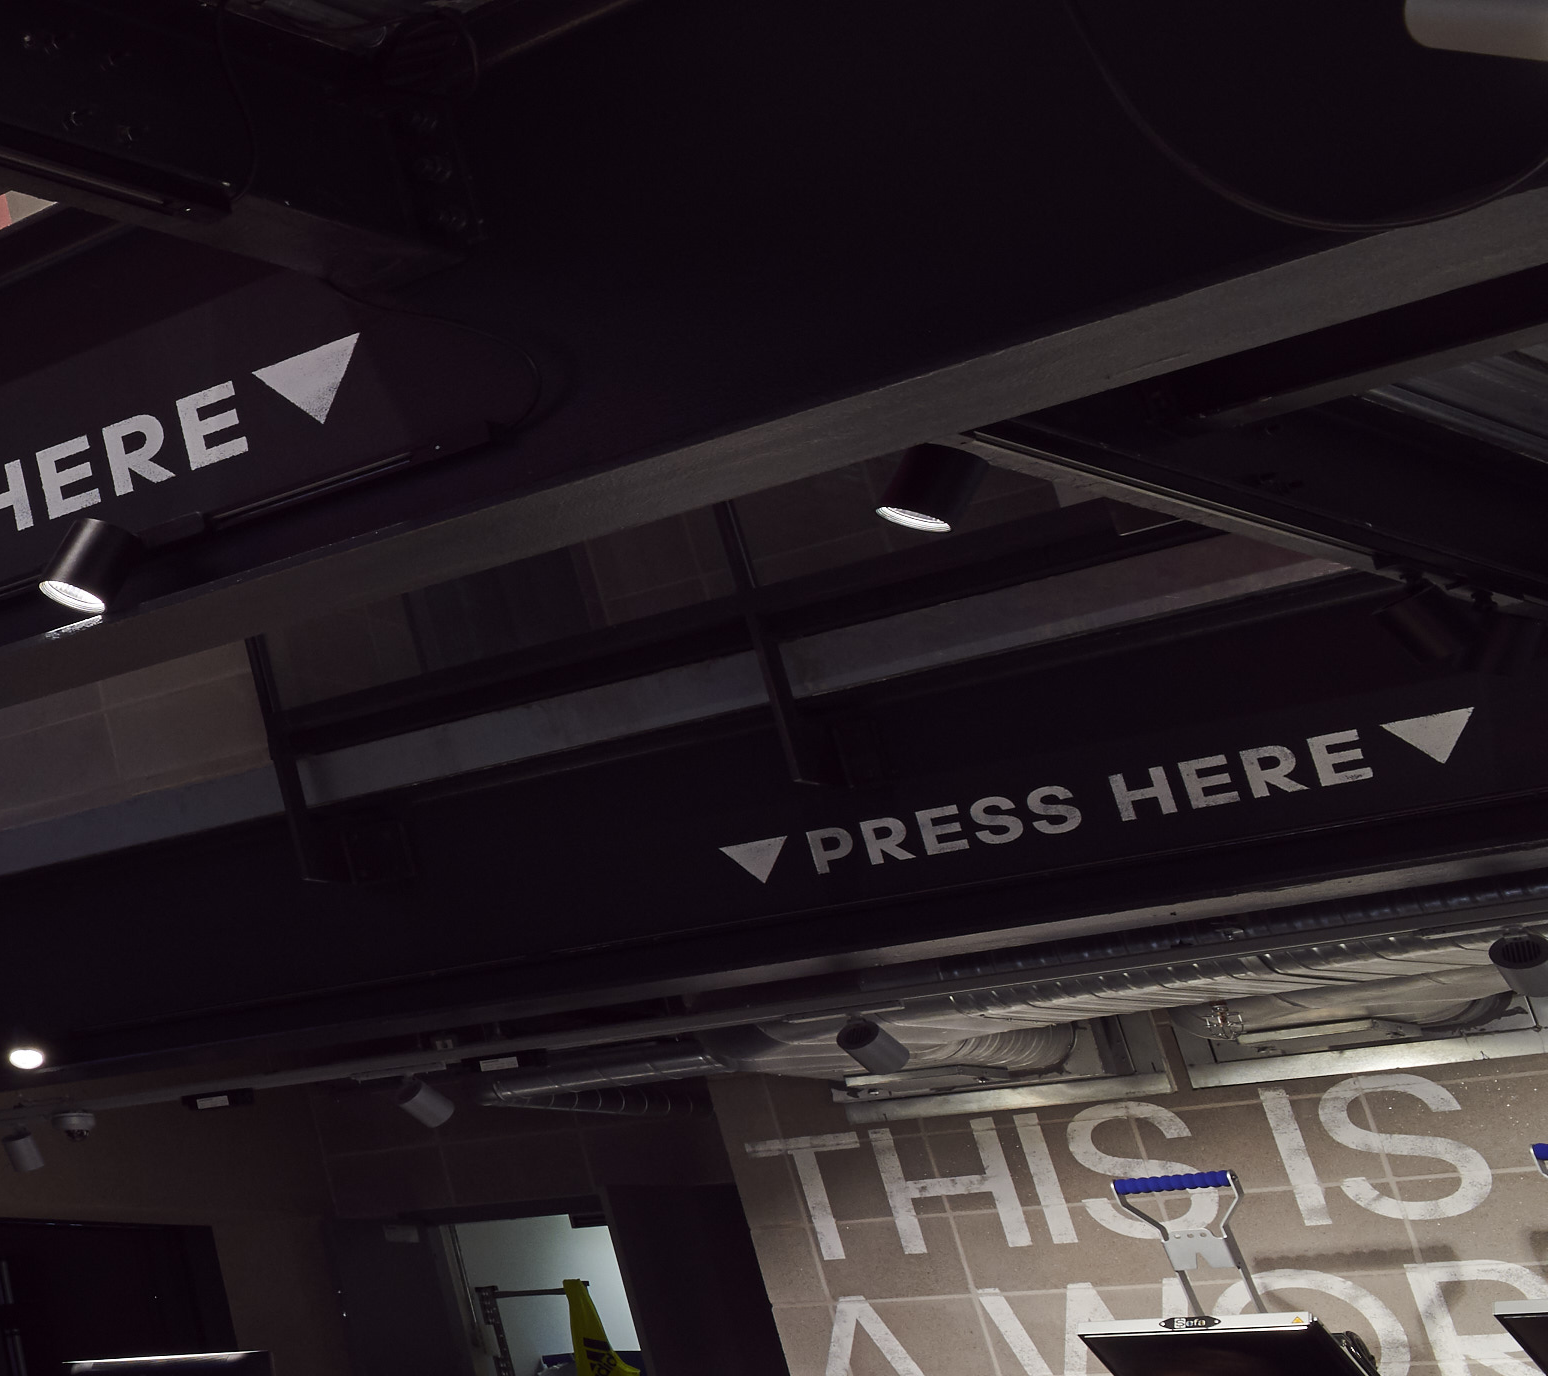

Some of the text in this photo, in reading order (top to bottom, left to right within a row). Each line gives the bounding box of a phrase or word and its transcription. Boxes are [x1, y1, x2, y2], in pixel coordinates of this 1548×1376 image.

[806, 729, 1373, 874] PRESS HERE
[745, 1072, 1492, 1260] THIS IS
